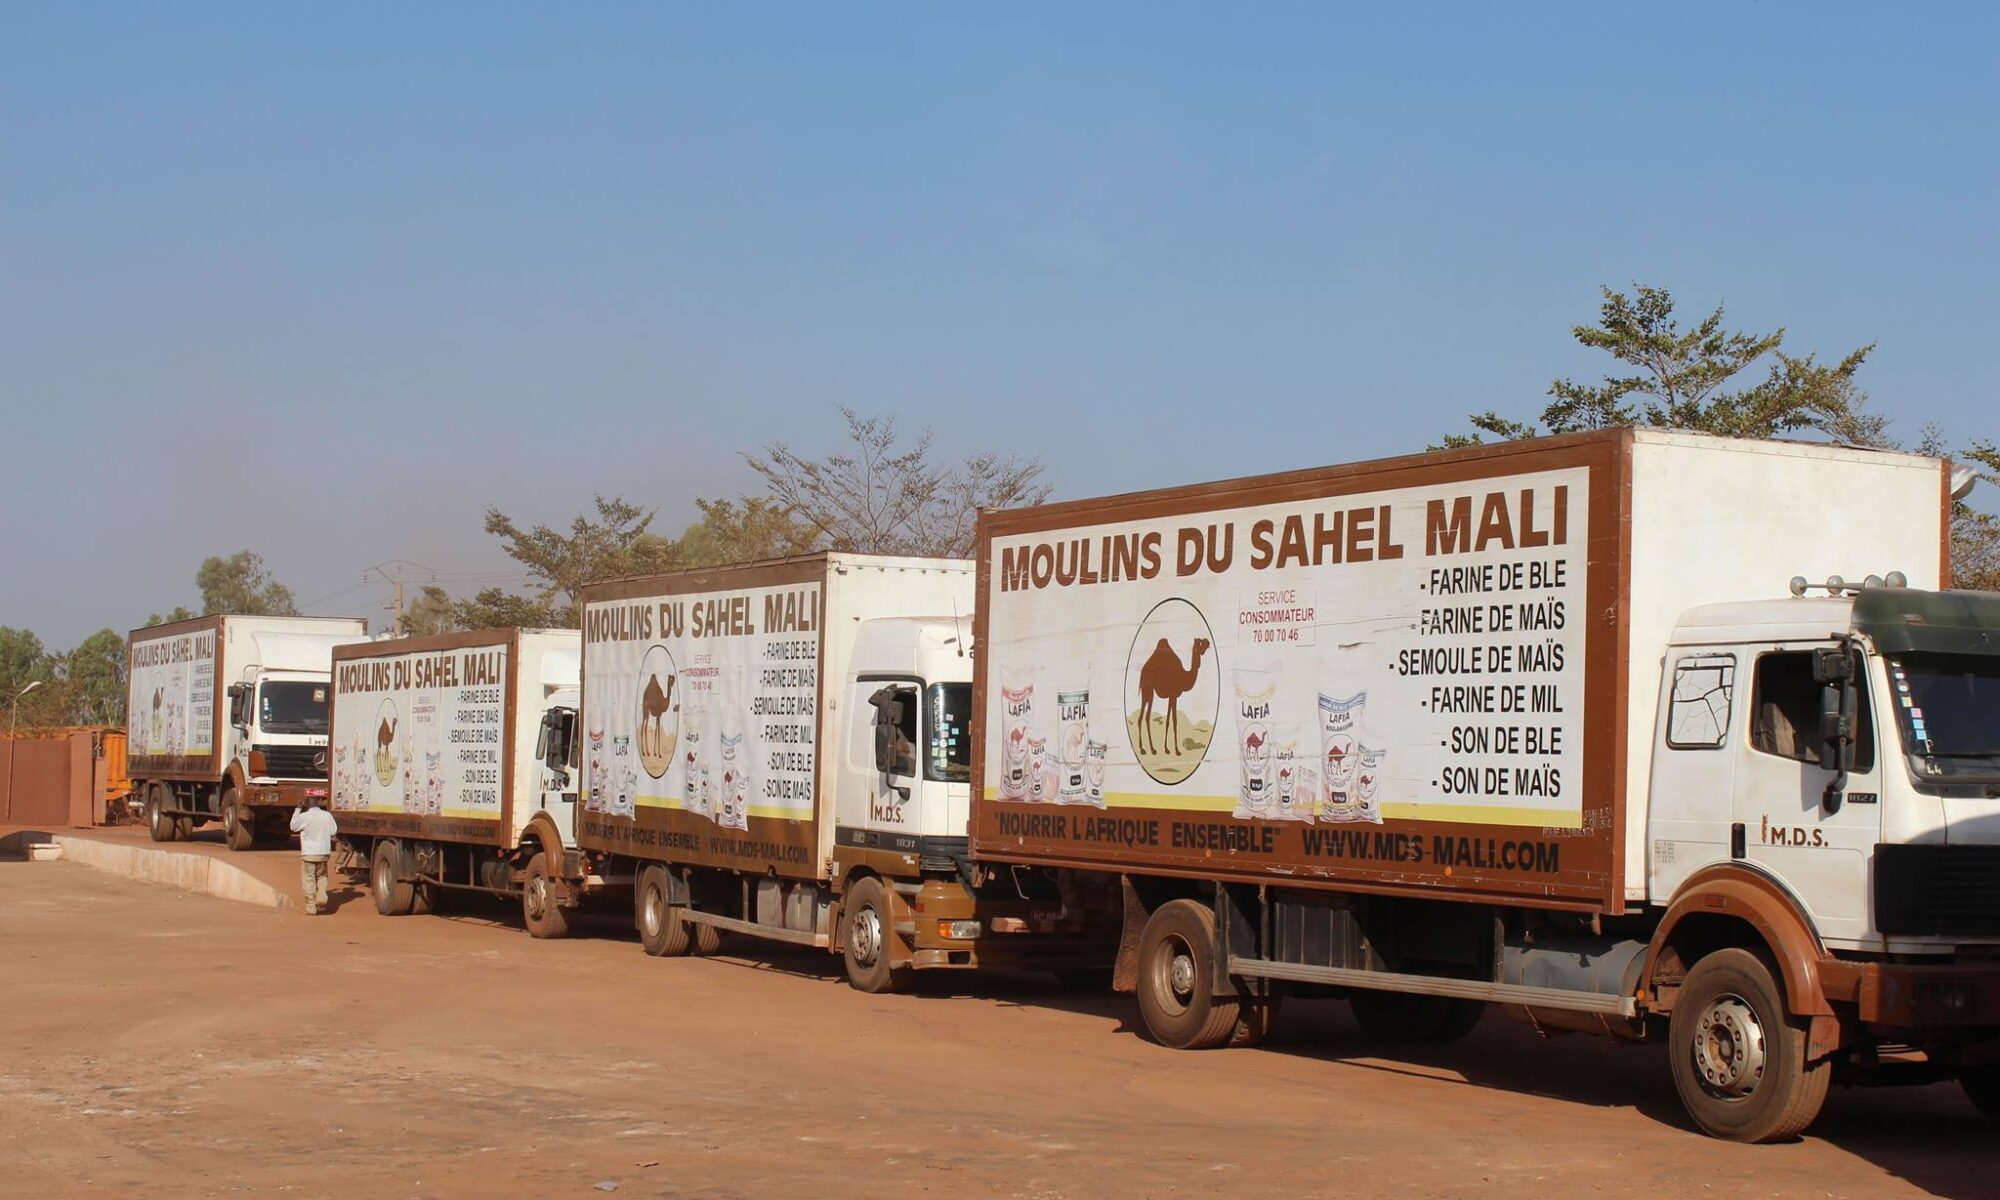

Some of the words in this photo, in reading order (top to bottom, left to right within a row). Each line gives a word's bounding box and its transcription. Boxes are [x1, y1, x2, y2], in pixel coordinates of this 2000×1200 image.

[1001, 531, 1161, 592] MOULINS
[1176, 522, 1234, 577] DU
[1250, 505, 1403, 570] SAHEL
[1425, 485, 1568, 556] MALI
[1430, 565, 1493, 595] FARINE
[1499, 562, 1523, 591] DE
[1529, 559, 1566, 589] BLE
[1258, 589, 1296, 605] SERVICE
[588, 605, 652, 643] MOULINS
[659, 602, 684, 639] DU
[692, 597, 754, 638] SAHEL
[764, 591, 817, 634] MALI
[1239, 607, 1315, 625] CONSOMMATEUR
[1421, 606, 1483, 636] FARINE
[1489, 604, 1513, 632] DE
[1519, 596, 1565, 631] MAÏS
[1253, 630, 1263, 642] 70
[1264, 629, 1275, 642] 00
[1277, 628, 1287, 642] 70
[1288, 628, 1299, 641] 46
[161, 642, 170, 665] DU
[172, 638, 193, 663] SAHEL
[195, 634, 214, 660] MALI
[767, 641, 789, 660] FARINE
[791, 641, 800, 659] DE
[802, 641, 816, 659] BLE
[1398, 647, 1482, 676] SEMOULE
[1488, 645, 1512, 673] DE
[1518, 638, 1564, 673] MAÏS
[339, 662, 390, 694] MOULINS
[394, 660, 411, 690] DU
[416, 655, 458, 688] SAHEL
[464, 652, 501, 686] MALI
[763, 669, 786, 687] FARINE
[788, 669, 797, 687] DE
[754, 696, 785, 715] SEMOULE
[786, 697, 796, 715] DE
[1009, 698, 1031, 717] LAFIA
[1431, 686, 1495, 713] FARINE
[1500, 685, 1525, 713] DE
[1531, 684, 1563, 713] MIL
[1061, 705, 1086, 721] LAFIA
[1242, 700, 1270, 720] LAFIA
[1329, 712, 1350, 723] LAFIA
[765, 725, 789, 743] FARINE
[790, 725, 798, 743] DE
[800, 725, 812, 744] MIL
[1451, 726, 1489, 754] SON
[1494, 726, 1519, 754] DE
[1525, 727, 1562, 755] BLE
[771, 752, 786, 770] SON
[787, 752, 795, 771] DE
[798, 753, 812, 772] BLE
[767, 779, 781, 797] SON
[783, 780, 791, 798] DE
[1442, 766, 1479, 794] SON
[1484, 767, 1509, 796] DE
[1515, 763, 1561, 798] MAÏS
[875, 805, 905, 823] M.D.S.
[1072, 815, 1160, 847] L'AFRIQUE
[1771, 827, 1829, 847] M.D.S.
[896, 838, 916, 848] 1831
[1302, 828, 1560, 873] WWW.MDS-MALI.COM
